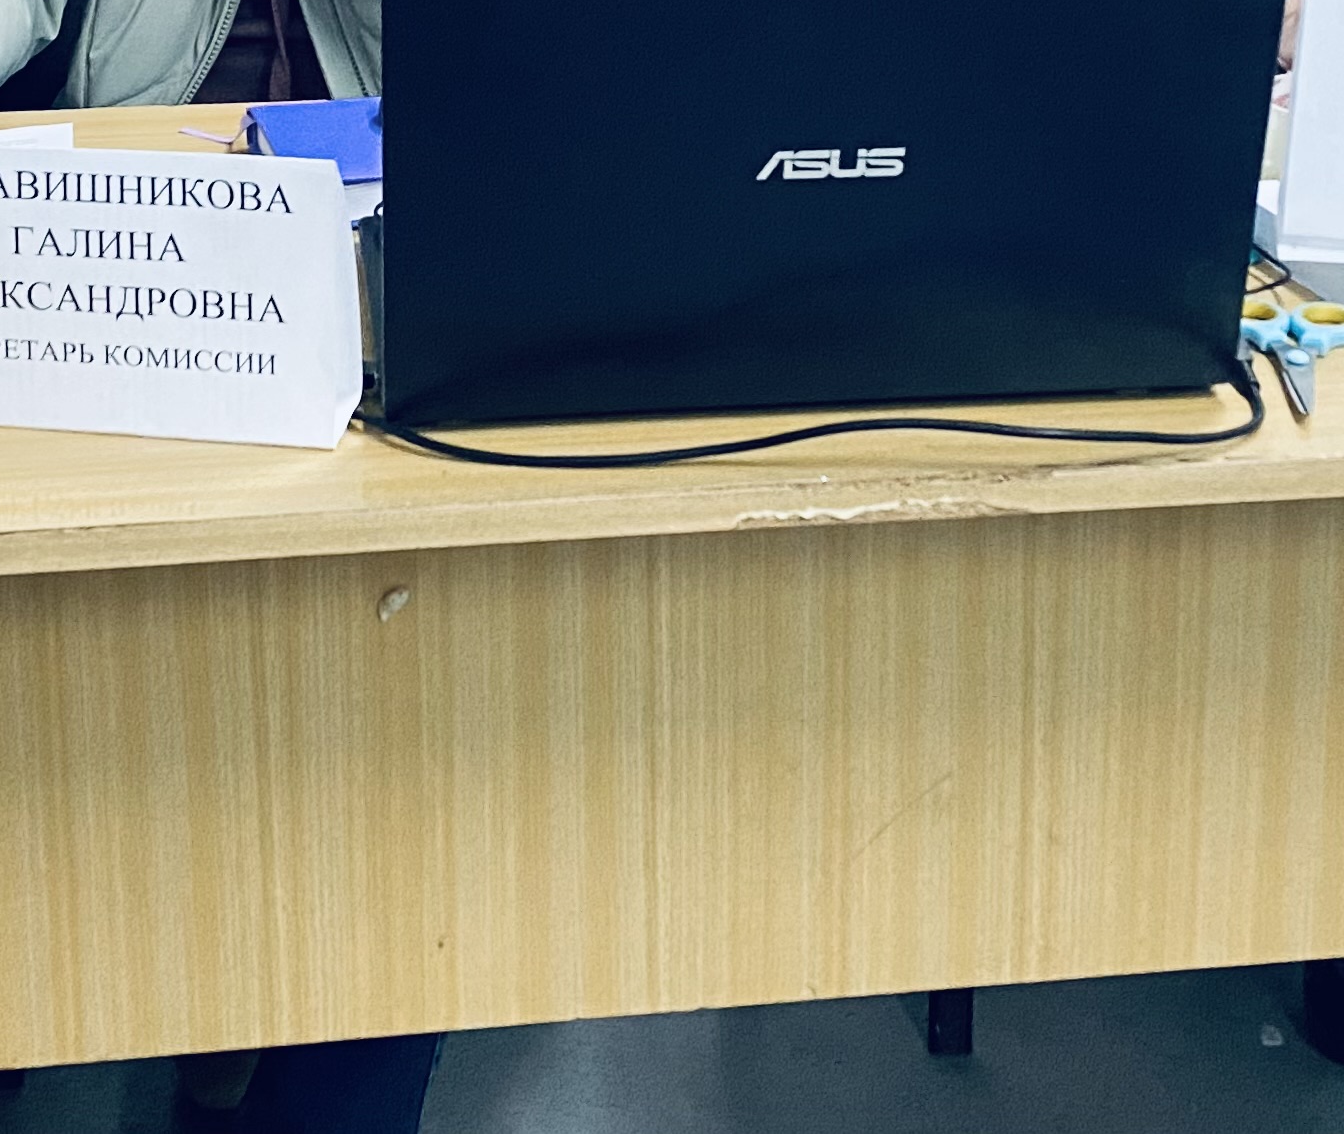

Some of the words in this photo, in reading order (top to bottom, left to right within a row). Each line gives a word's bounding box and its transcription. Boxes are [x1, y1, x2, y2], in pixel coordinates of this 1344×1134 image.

[756, 147, 906, 181] ASUS
[12, 225, 187, 264] ГАЛИНА
[103, 344, 277, 376] КОМИССИИ
